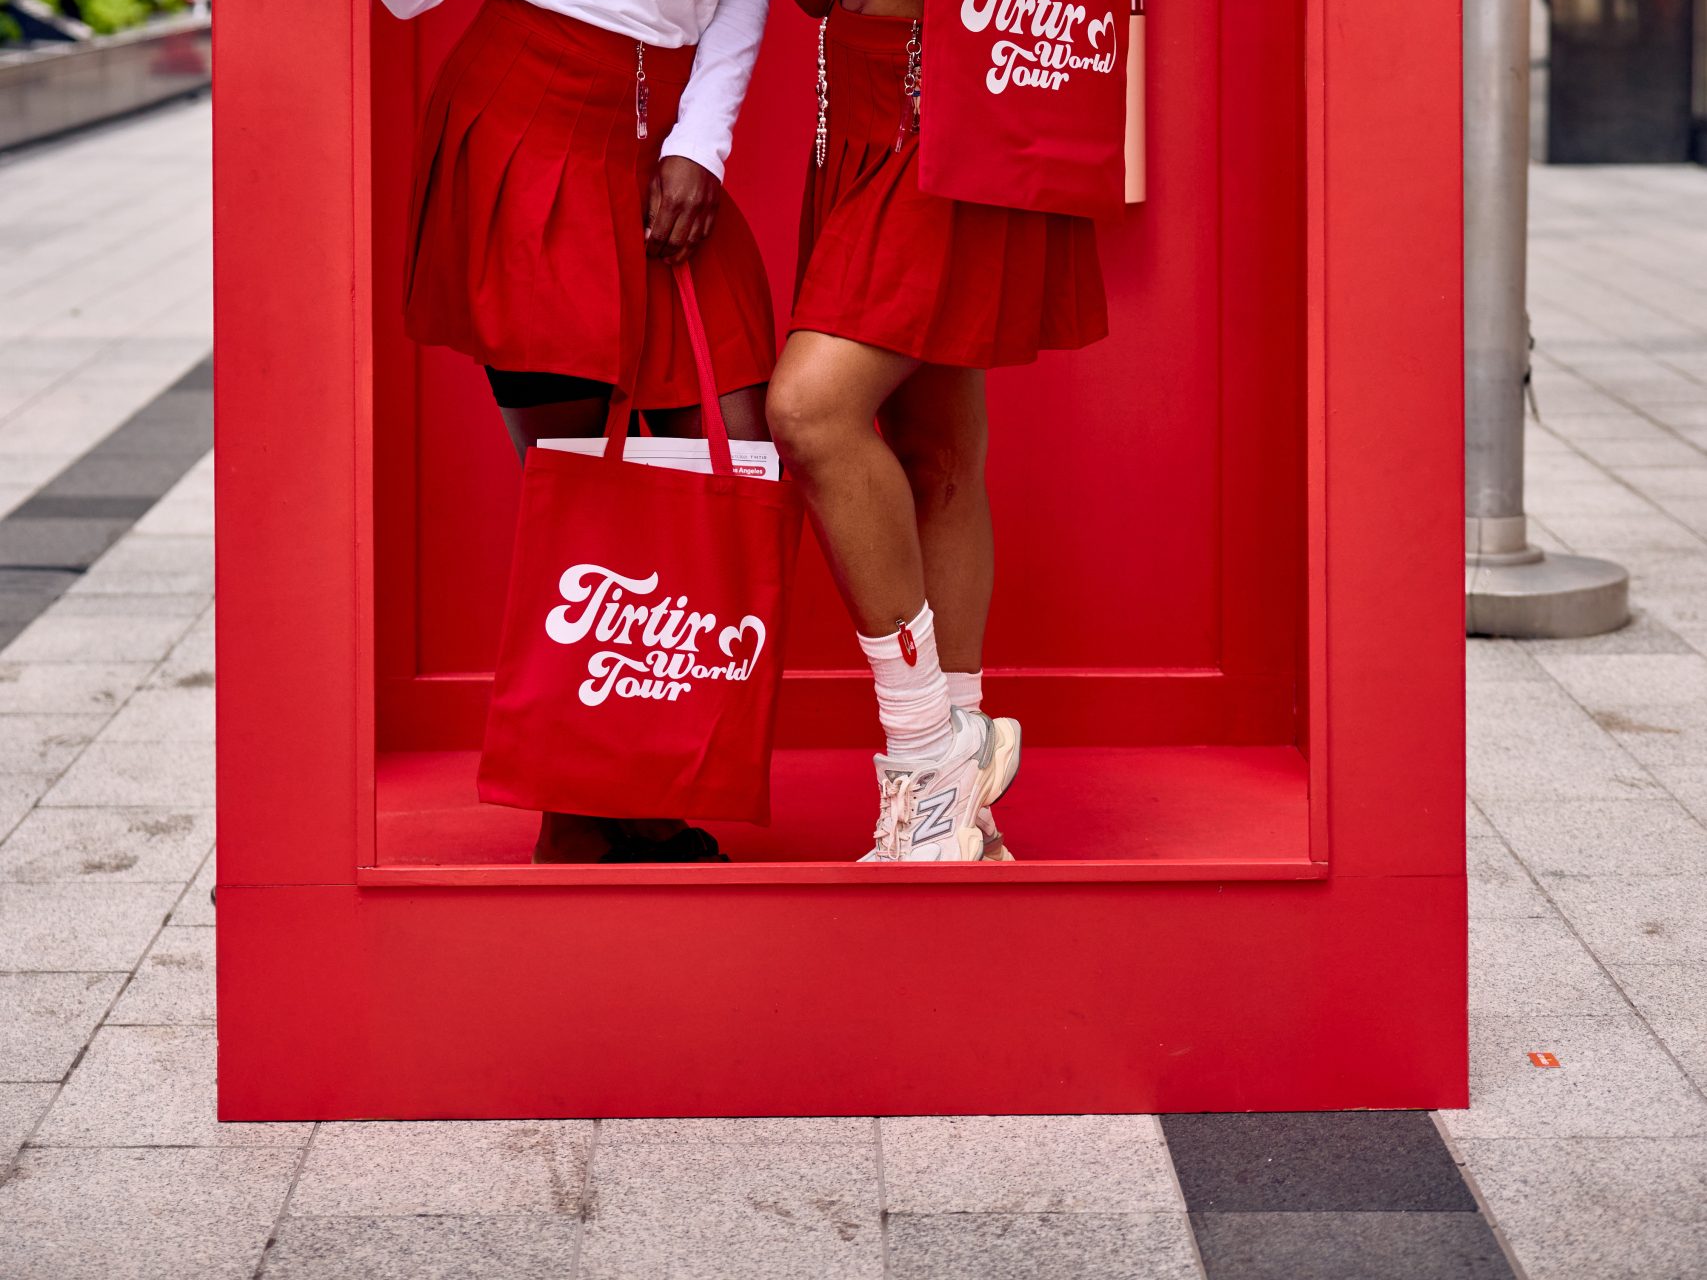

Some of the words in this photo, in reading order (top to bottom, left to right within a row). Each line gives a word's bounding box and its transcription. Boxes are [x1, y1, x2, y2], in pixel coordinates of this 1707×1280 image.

[985, 40, 1070, 95] Tour
[1034, 40, 1111, 74] World
[738, 467, 764, 475] Angeles
[545, 563, 717, 652] Tirtir
[578, 650, 692, 707] Tour
[645, 650, 750, 681] World
